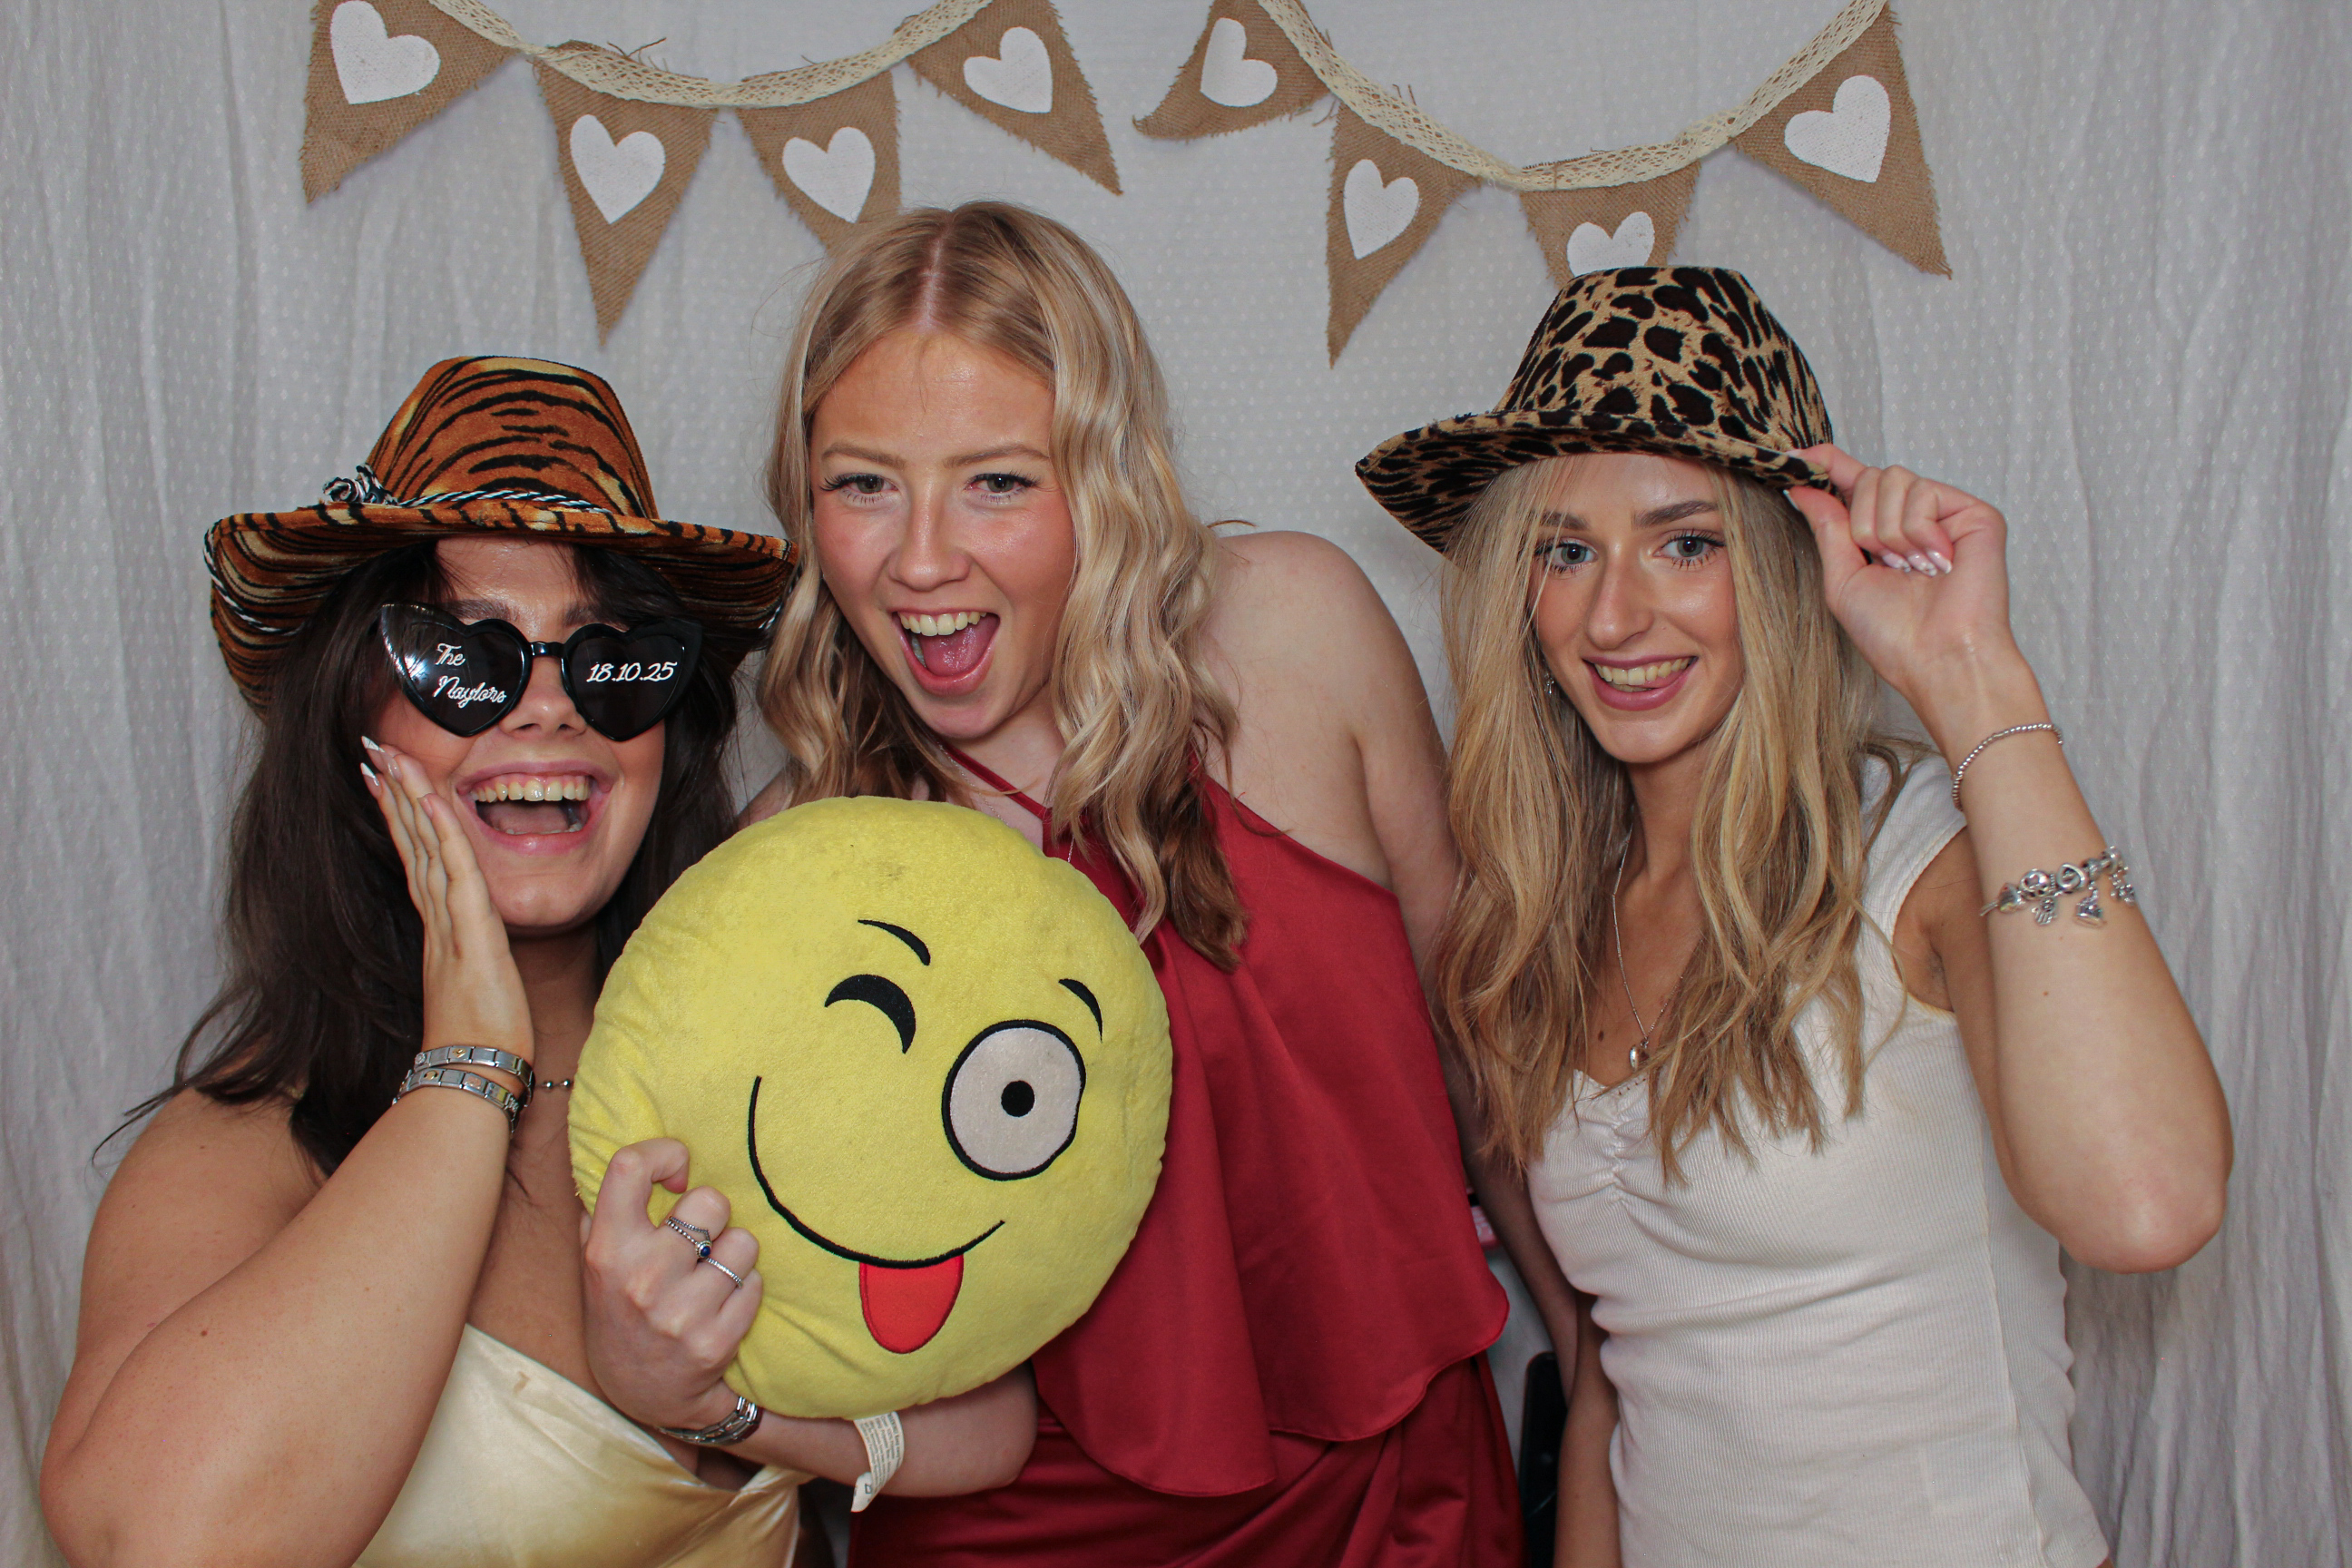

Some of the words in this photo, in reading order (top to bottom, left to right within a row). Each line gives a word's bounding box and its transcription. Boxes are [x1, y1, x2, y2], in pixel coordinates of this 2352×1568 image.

[435, 642, 466, 666] The
[585, 662, 678, 682] 18.10.25
[433, 675, 507, 709] Naylors
